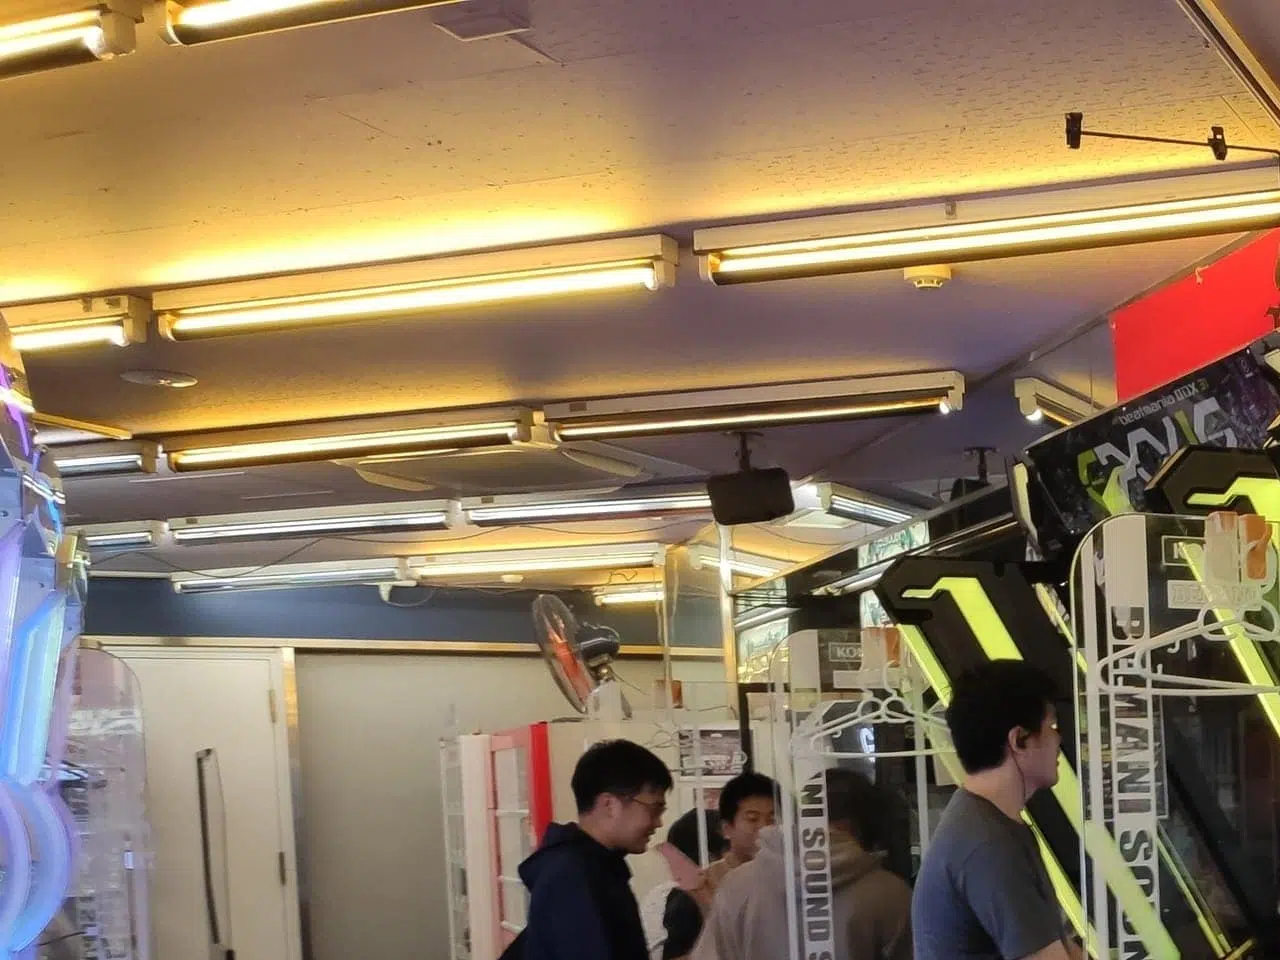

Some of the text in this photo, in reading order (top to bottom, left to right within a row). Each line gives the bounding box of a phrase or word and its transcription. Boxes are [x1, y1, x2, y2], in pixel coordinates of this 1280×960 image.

[1118, 394, 1176, 426] beatmania
[1111, 606, 1152, 814] BEMANI
[802, 828, 831, 942] SOUND
